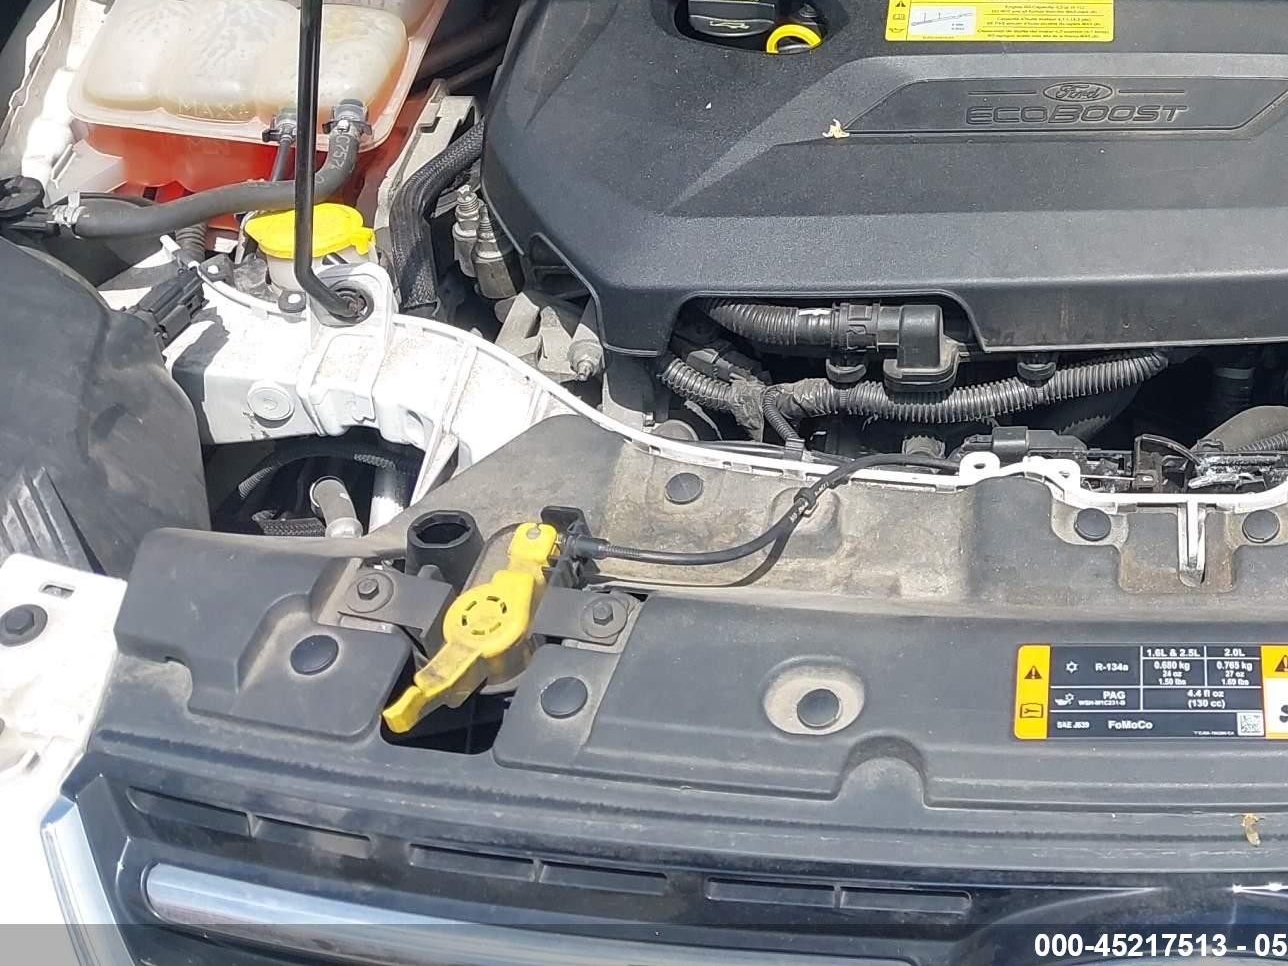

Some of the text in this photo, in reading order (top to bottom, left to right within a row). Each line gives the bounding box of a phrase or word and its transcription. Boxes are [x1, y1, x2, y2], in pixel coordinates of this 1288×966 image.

[1055, 84, 1101, 100] Ford
[1180, 648, 1200, 657] 2.5L
[1224, 648, 1245, 657] 2.0L
[1095, 663, 1129, 671] R-134a
[1179, 661, 1190, 671] kg
[1241, 661, 1253, 671] kg
[1103, 691, 1126, 699] PAG
[1188, 700, 1226, 709] (130 cc)
[1108, 720, 1153, 729] FoMoCo
